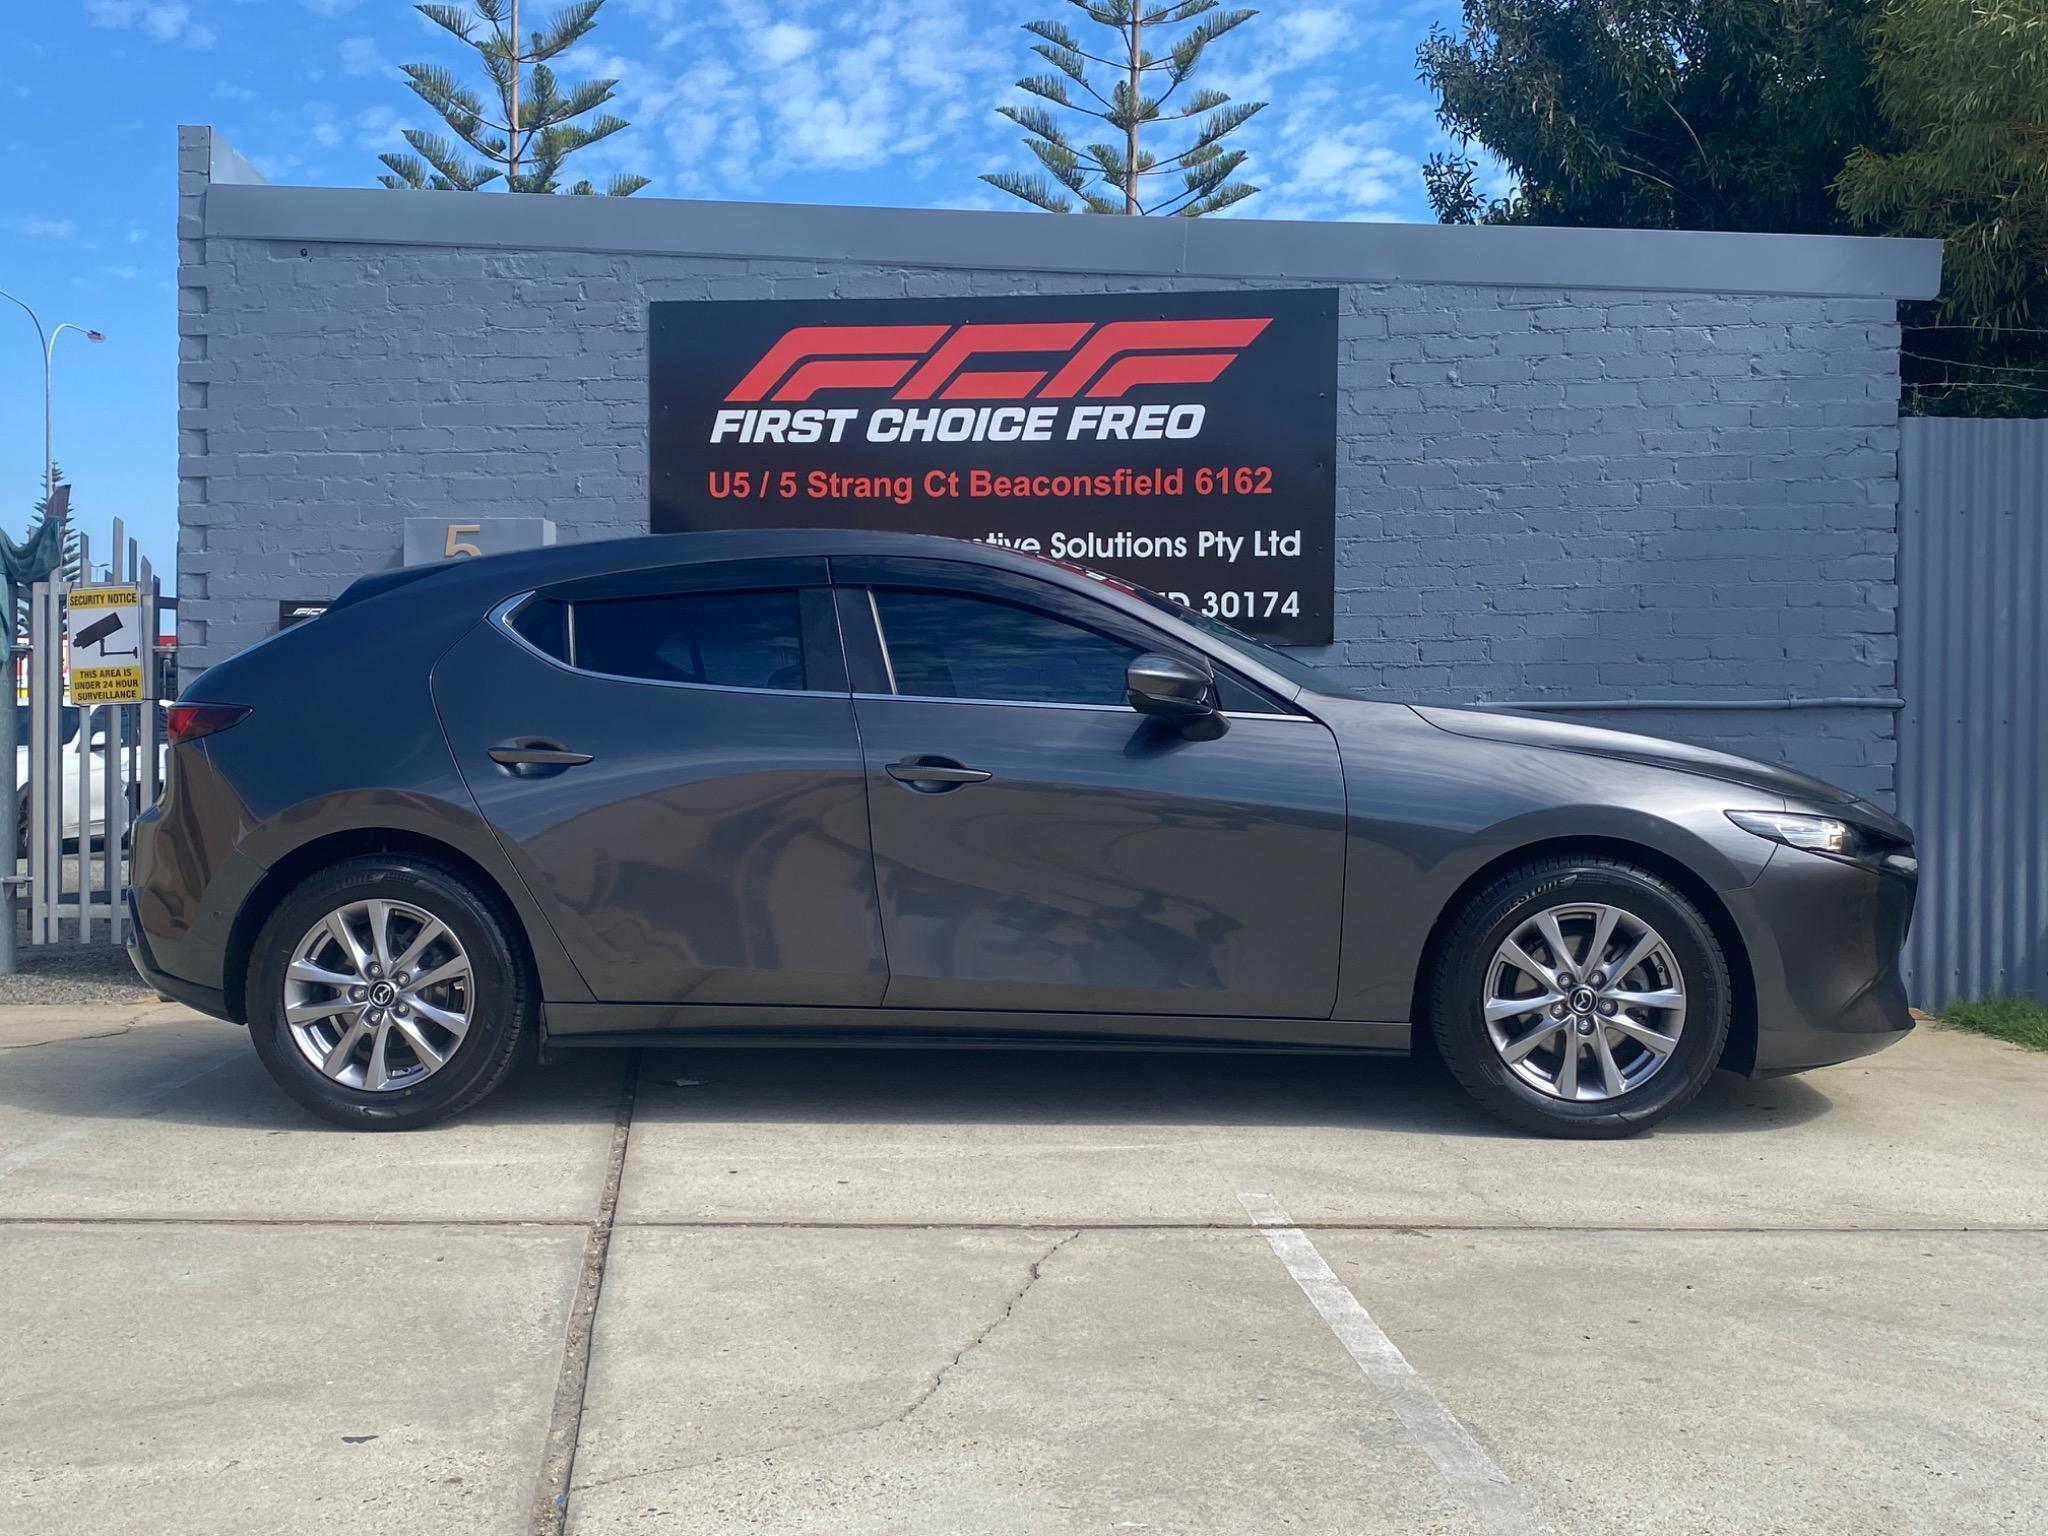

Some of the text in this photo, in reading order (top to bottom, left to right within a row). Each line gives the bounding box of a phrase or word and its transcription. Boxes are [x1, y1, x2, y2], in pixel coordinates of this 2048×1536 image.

[710, 404, 1207, 445] FIRST CHOICE FREO
[708, 468, 1273, 505] U5 / 5 Strang Ct Beaconsfield 6162
[445, 524, 482, 558] 5
[1050, 531, 1188, 560] Solutions
[1198, 530, 1245, 563] Pty
[1254, 530, 1301, 558] Ltd
[70, 592, 137, 606] SECURITY NOTICE
[1201, 591, 1301, 619] 30174
[74, 679, 139, 690] UNDER 24 HOUR
[80, 668, 132, 679] THIS AREA IS
[77, 690, 137, 701] SURVEILLANCE
